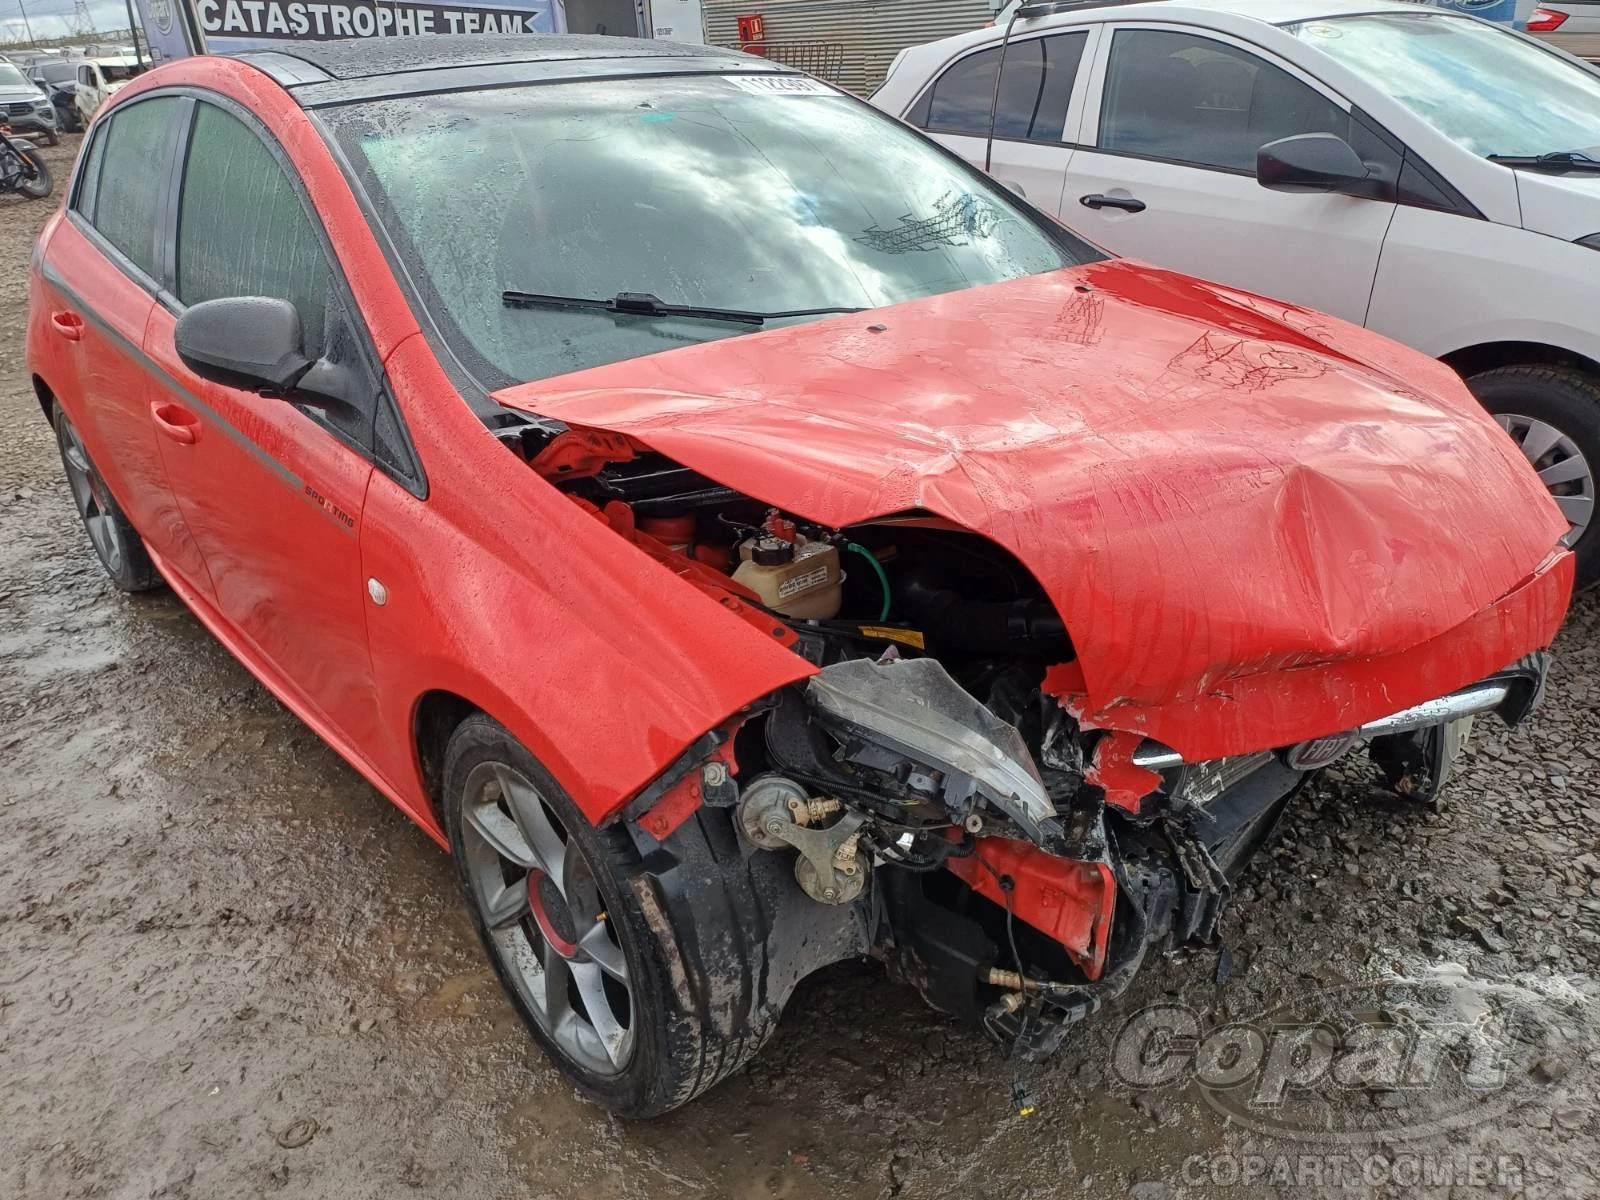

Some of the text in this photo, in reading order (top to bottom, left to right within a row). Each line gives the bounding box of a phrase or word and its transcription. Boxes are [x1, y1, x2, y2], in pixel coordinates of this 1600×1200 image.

[199, 0, 435, 37] CATASTROPHE
[443, 11, 523, 34] TEAM
[1302, 737, 1348, 759] FIAT
